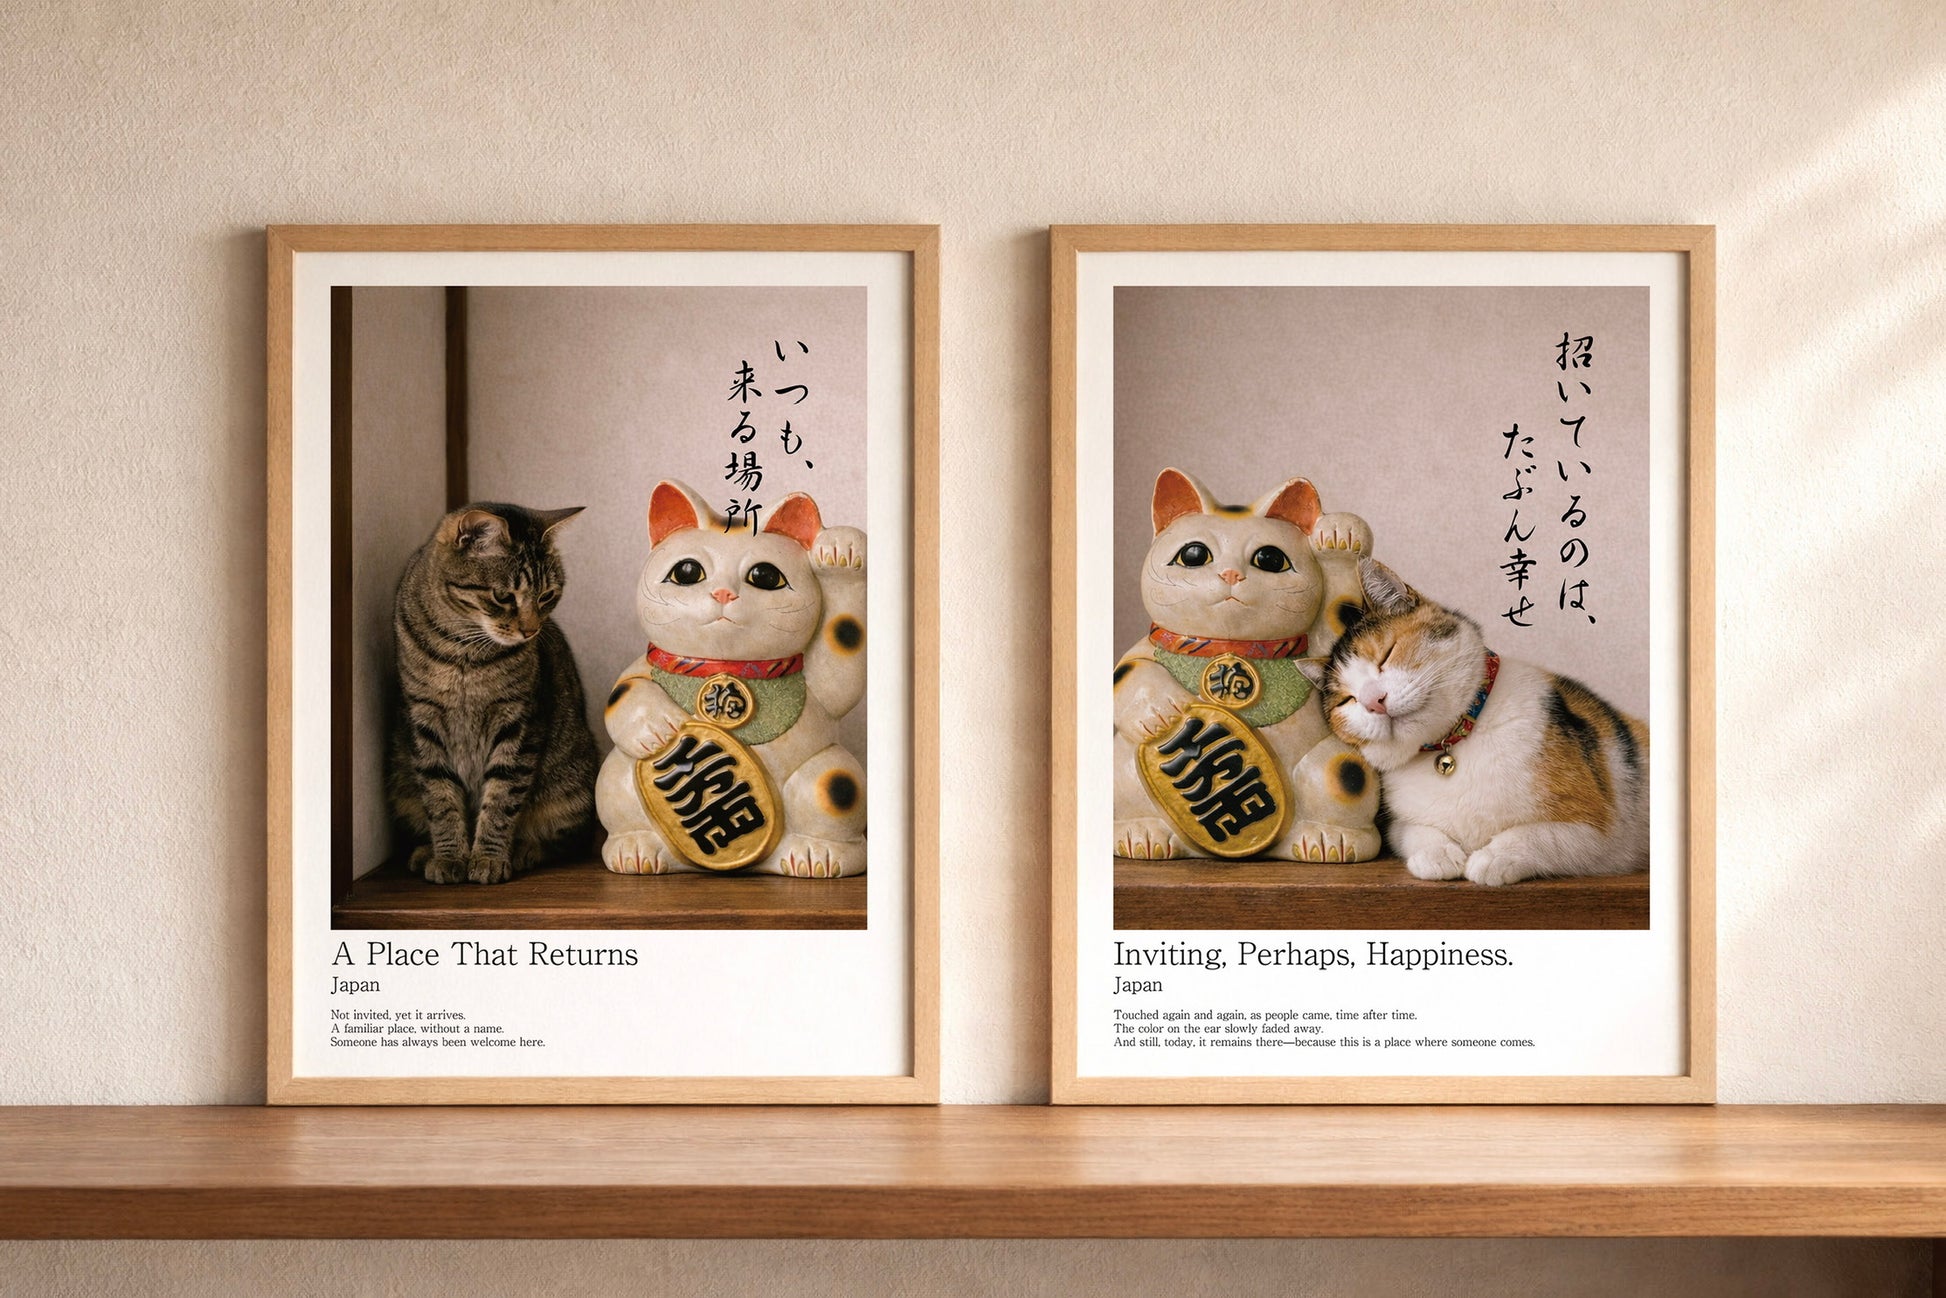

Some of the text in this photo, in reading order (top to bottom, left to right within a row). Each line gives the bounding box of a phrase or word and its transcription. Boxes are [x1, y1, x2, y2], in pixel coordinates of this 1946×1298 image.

[774, 340, 814, 470] いつも、
[723, 359, 764, 538] 来る場所
[1555, 331, 1597, 625] 招いているのは、
[1499, 422, 1538, 628] たぶん幸せ
[332, 941, 638, 966] A Place That Returns
[1114, 941, 1513, 970] Inviting, Perhaps, Happiness.
[331, 976, 380, 995] Japan
[1113, 976, 1163, 995] Japan
[330, 1008, 466, 1022] Not invited, yet it arrives.
[1113, 1008, 1418, 1022] Touched again and again, as people came, time after time.
[330, 1022, 505, 1036] A familiar place, without a name.
[1112, 1022, 1324, 1036] The color on the ear slowly faded away.
[330, 1036, 546, 1049] Someone has always been welcome here.
[1113, 1036, 1137, 1047] And
[1139, 1036, 1161, 1048] still,
[1164, 1036, 1196, 1049] today,
[1198, 1036, 1207, 1047] it
[1210, 1036, 1253, 1048] remains
[1339, 1036, 1360, 1047] this
[1362, 1036, 1372, 1047] is
[1374, 1039, 1381, 1047] a
[1384, 1036, 1412, 1049] place
[1414, 1036, 1448, 1047] where
[1450, 1039, 1497, 1047] someone
[1499, 1039, 1536, 1047] comes.
